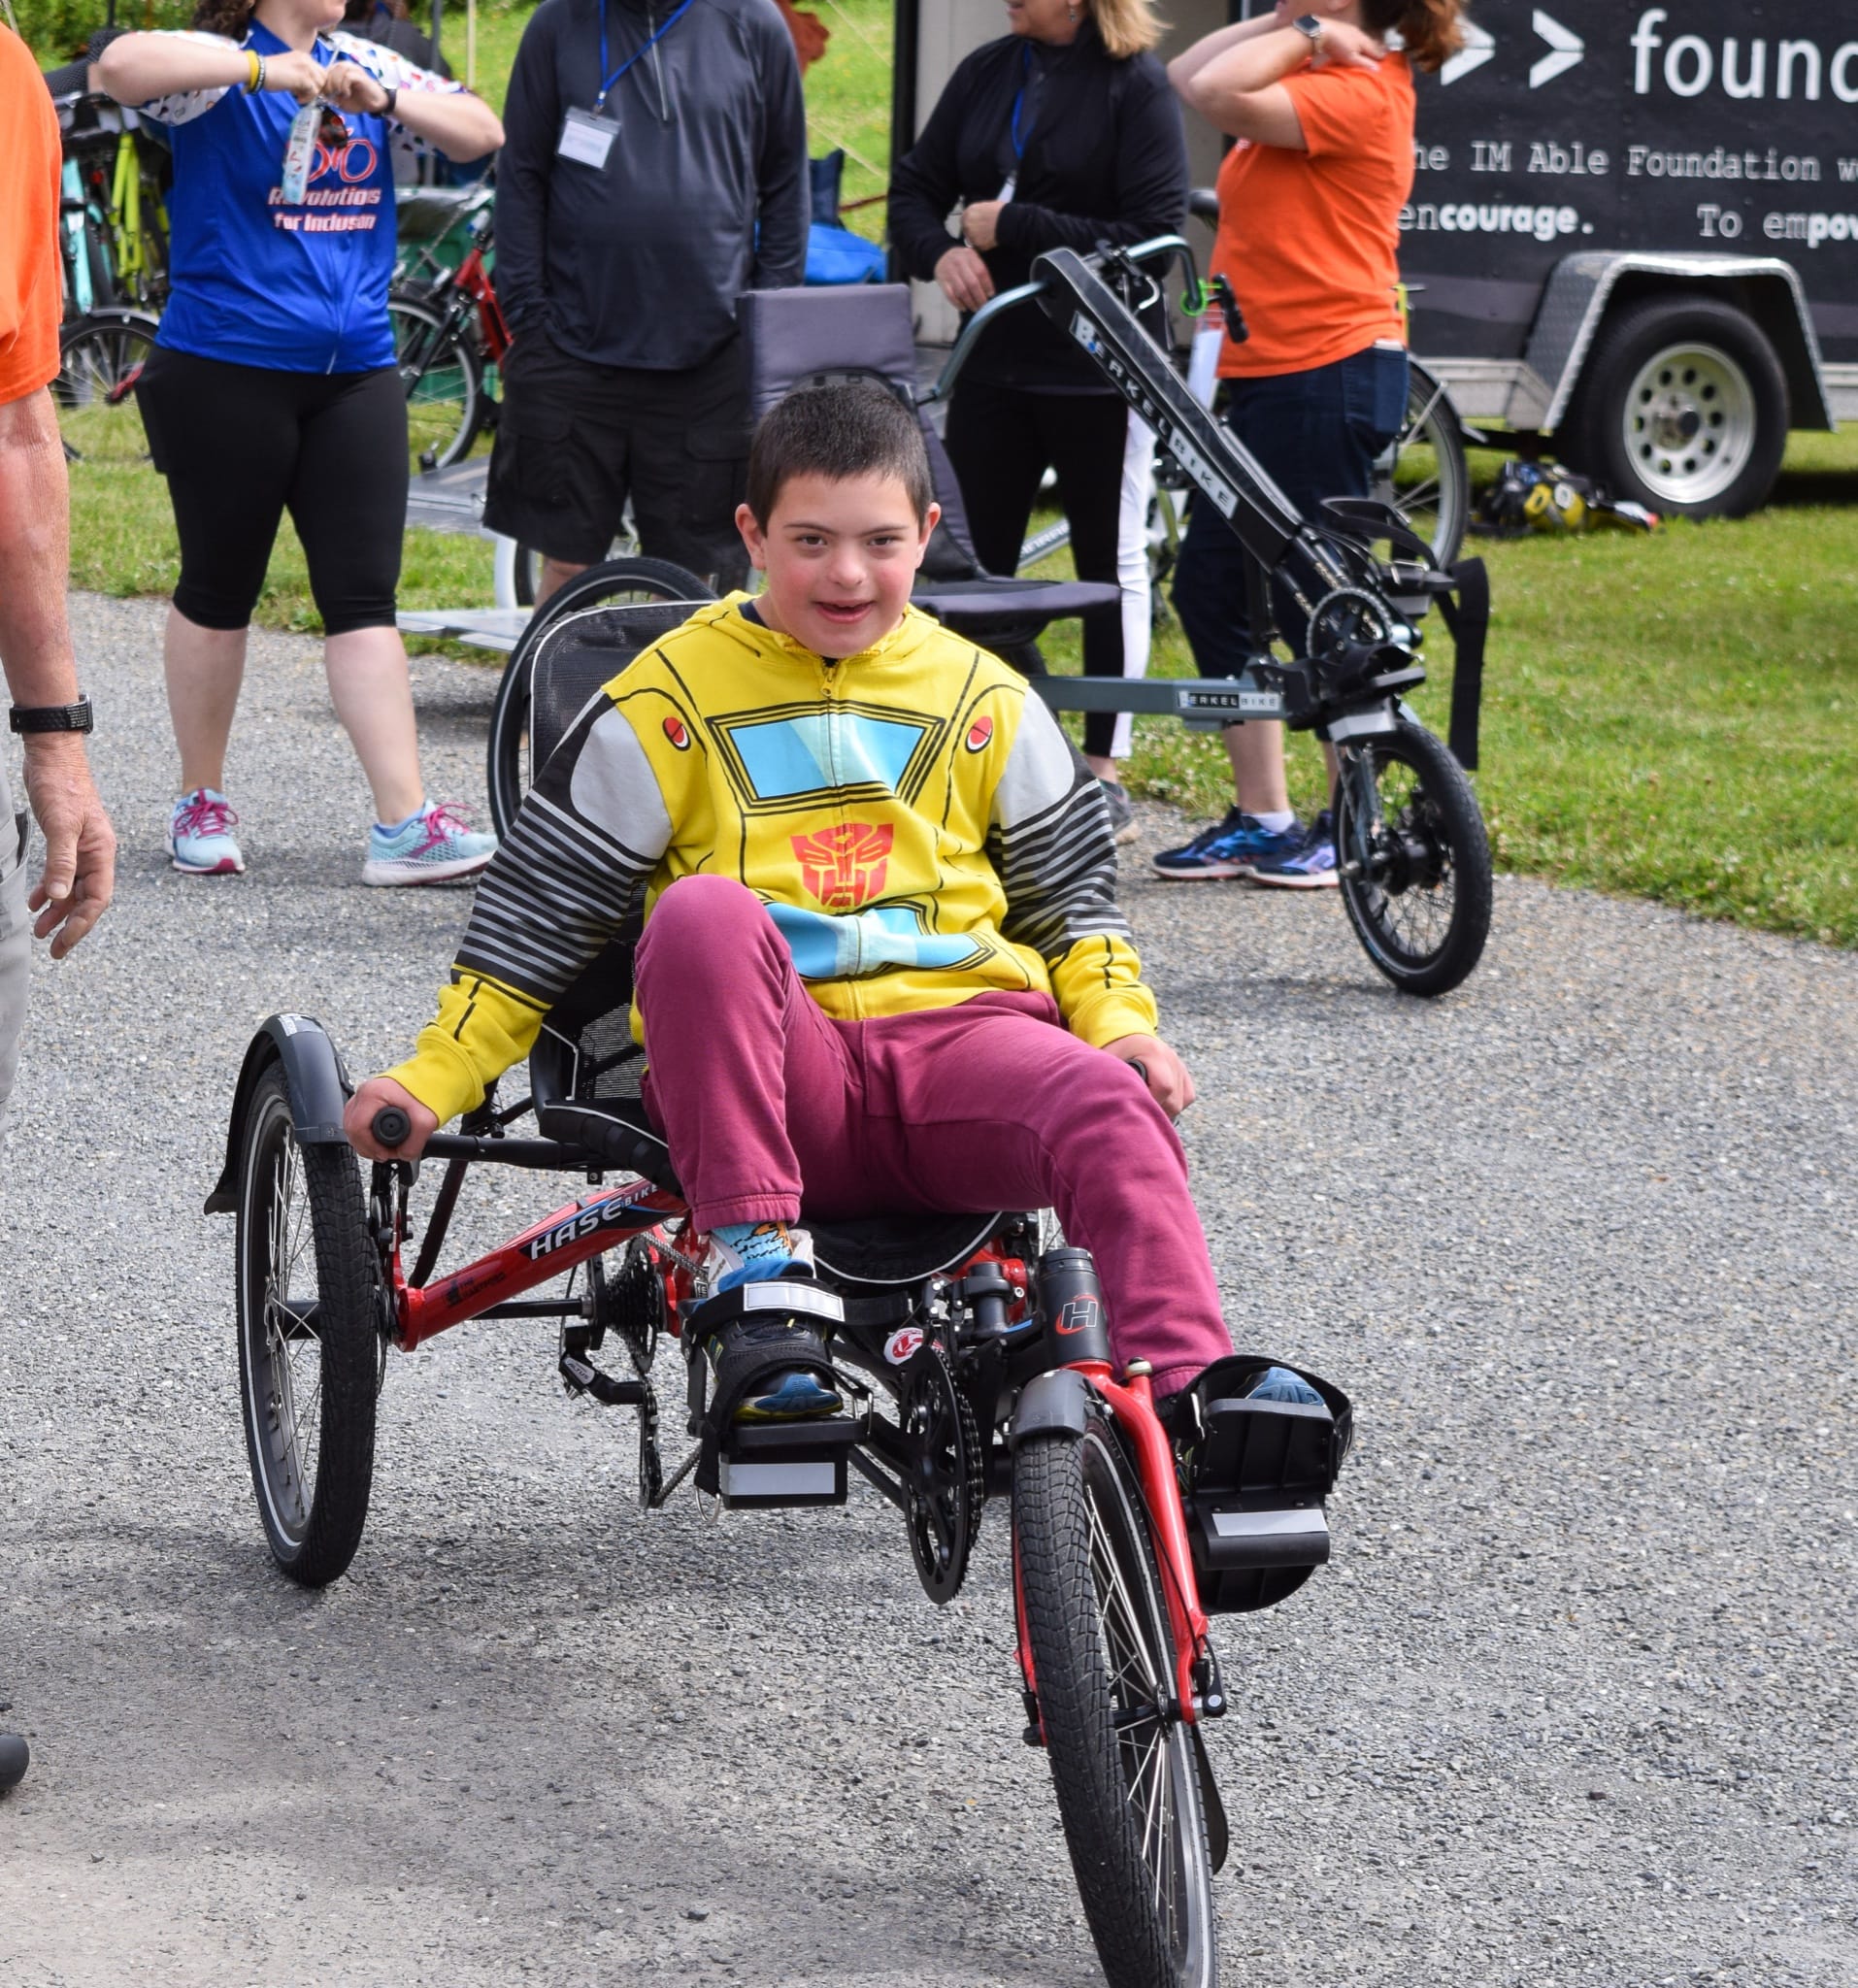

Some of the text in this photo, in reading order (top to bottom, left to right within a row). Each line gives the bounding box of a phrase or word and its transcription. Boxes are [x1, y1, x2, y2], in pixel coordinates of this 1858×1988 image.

[1413, 139, 1858, 182] he IM Able Foundation w
[275, 213, 303, 231] for
[1697, 203, 1743, 239] To
[531, 1183, 658, 1261] HASE BIKE
